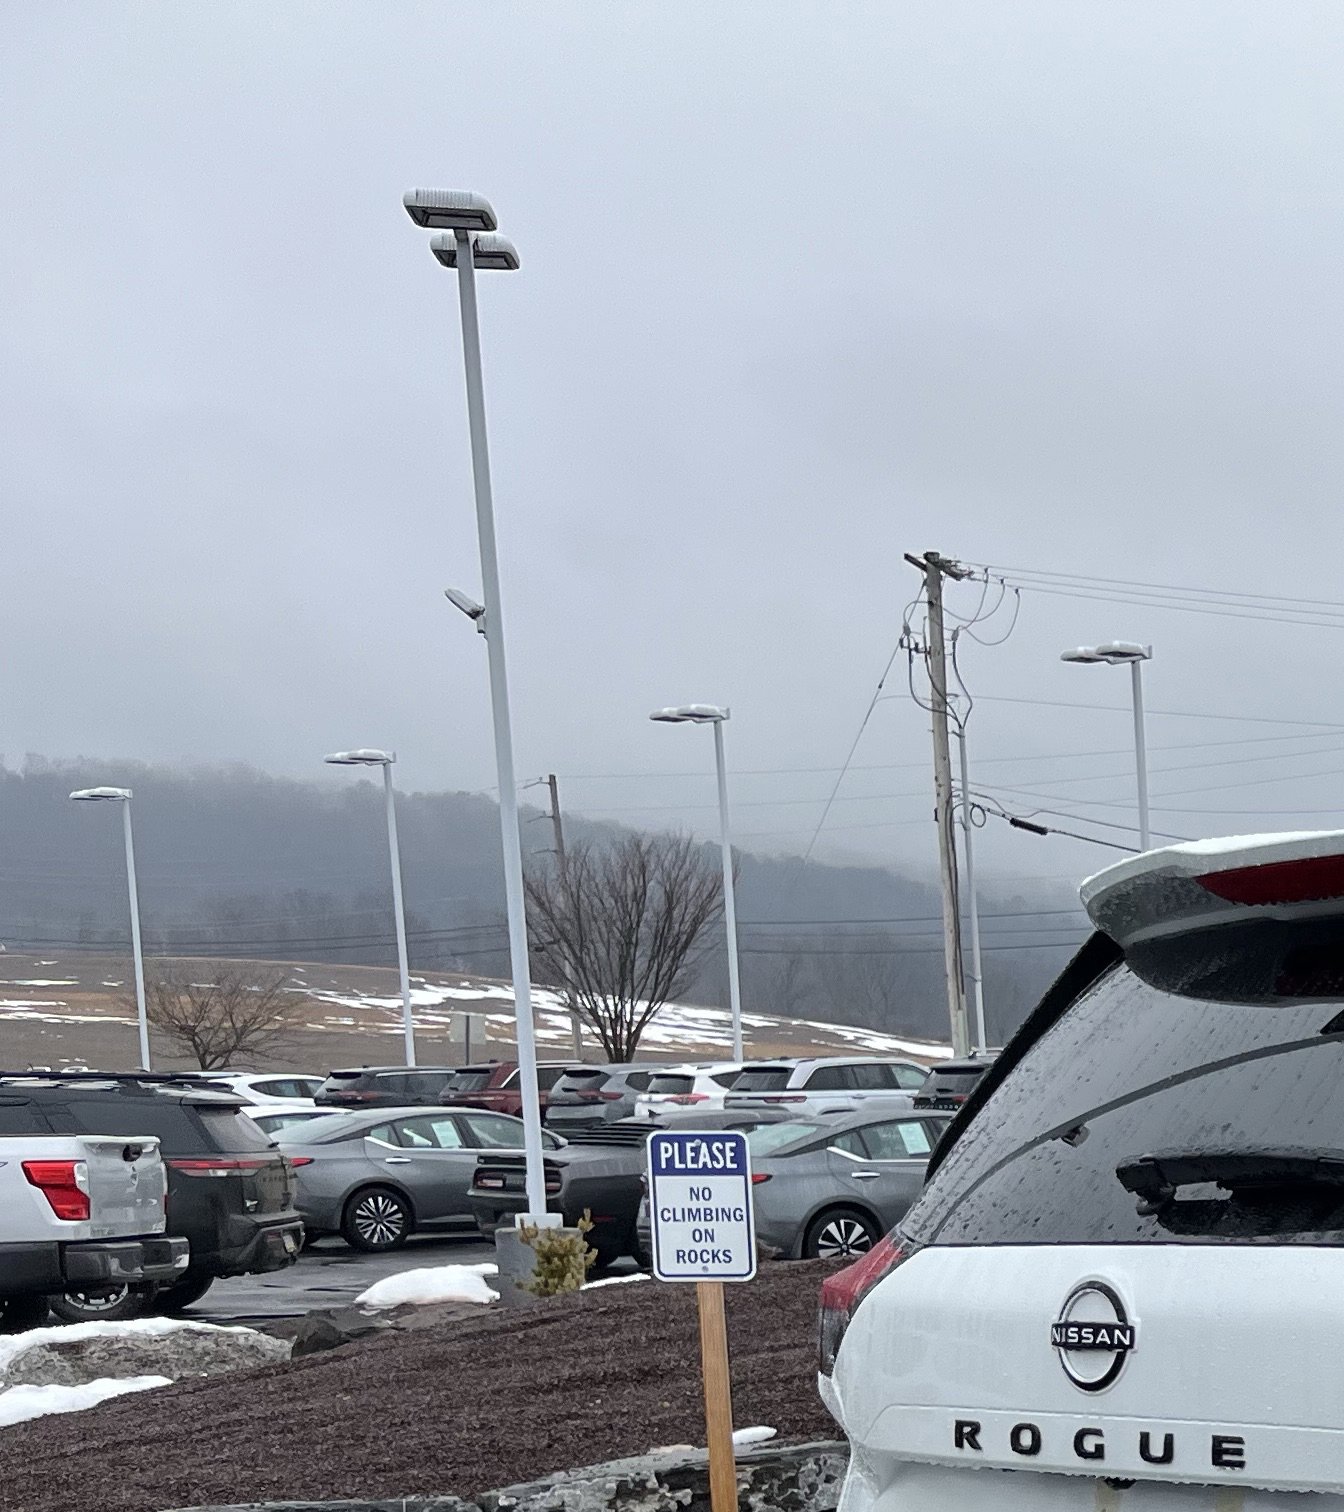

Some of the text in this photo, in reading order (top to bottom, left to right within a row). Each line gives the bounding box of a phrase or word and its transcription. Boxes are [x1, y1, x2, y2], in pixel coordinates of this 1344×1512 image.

[660, 1142, 737, 1168] PLEASE
[689, 1187, 712, 1201] NO
[660, 1207, 744, 1222] CLIMBING
[692, 1228, 715, 1243] ON
[676, 1249, 733, 1264] ROCKS
[1052, 1327, 1131, 1346] NISSAN
[954, 1419, 1247, 1468] ROGUE
